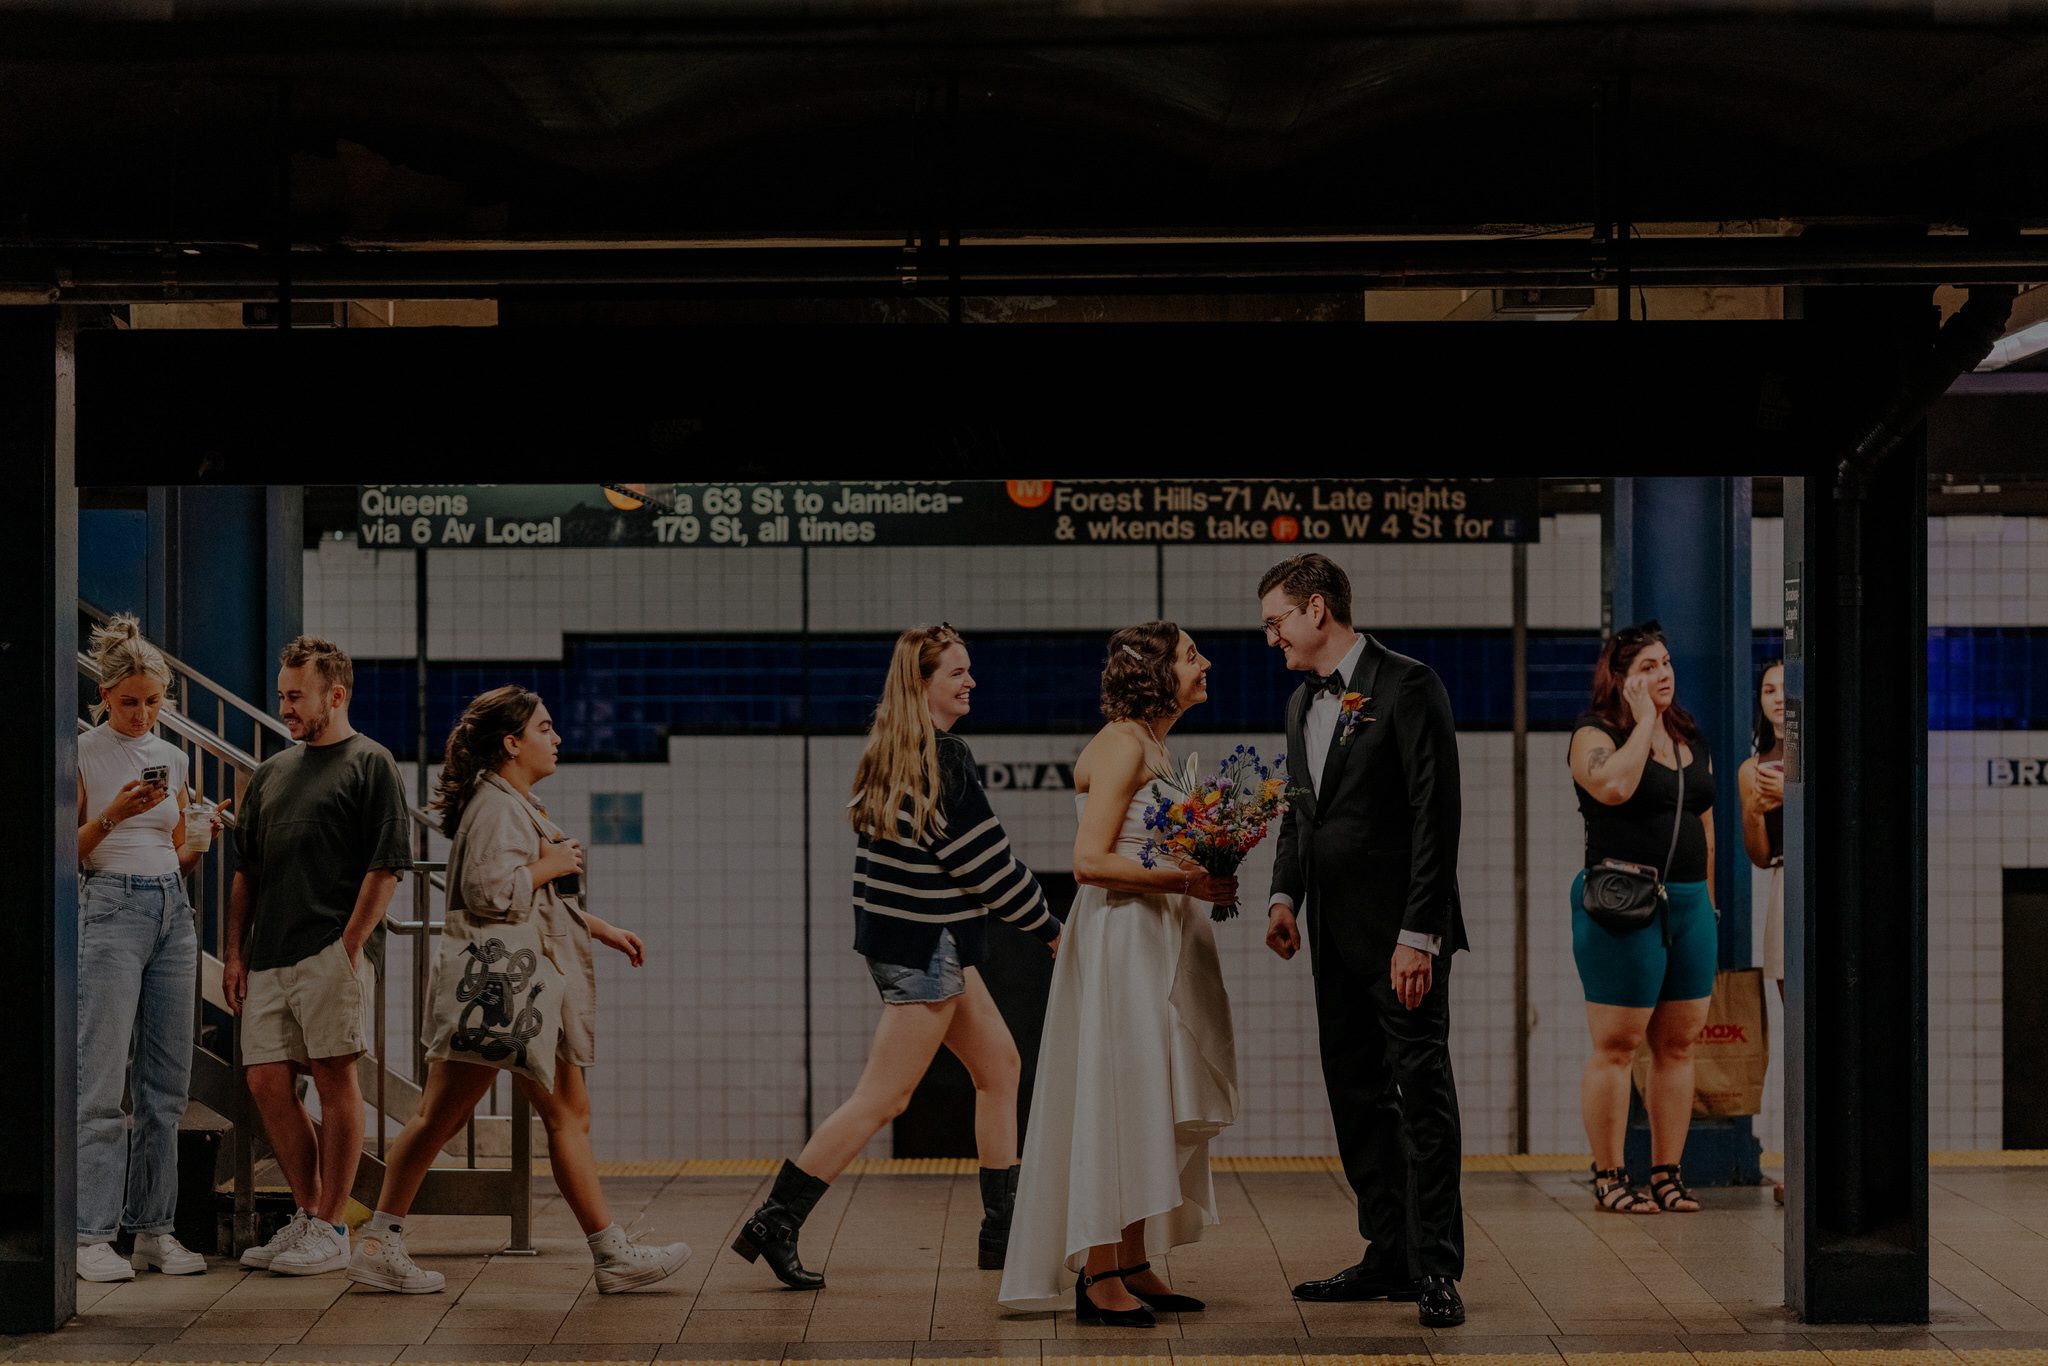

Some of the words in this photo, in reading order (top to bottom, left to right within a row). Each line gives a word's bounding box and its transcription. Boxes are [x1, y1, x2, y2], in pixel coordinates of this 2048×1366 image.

[361, 489, 468, 517] Queens
[703, 487, 742, 515] 63
[751, 487, 784, 515] St
[793, 488, 823, 514] to
[832, 487, 963, 514] Jamaica-
[1054, 487, 1144, 512] Forest
[1154, 486, 1251, 512] Hills-71
[1262, 487, 1301, 511] Av.
[1312, 486, 1373, 511] Late
[1384, 486, 1467, 515] nights
[362, 517, 400, 544] via
[411, 517, 432, 544] 6
[441, 517, 475, 544] Av
[485, 516, 561, 544] Local
[652, 516, 700, 543] 179
[710, 516, 749, 547] St,
[758, 515, 789, 542] all
[799, 516, 876, 543] times
[1055, 515, 1076, 540] &
[1088, 515, 1195, 540] wkends
[1206, 514, 1267, 539] take
[1302, 515, 1331, 539] to
[1341, 514, 1370, 538] W
[1381, 514, 1400, 538] 4
[1412, 513, 1443, 538] St
[1454, 513, 1493, 538] for
[984, 762, 1074, 789] DWA
[1991, 759, 2048, 785] BR
